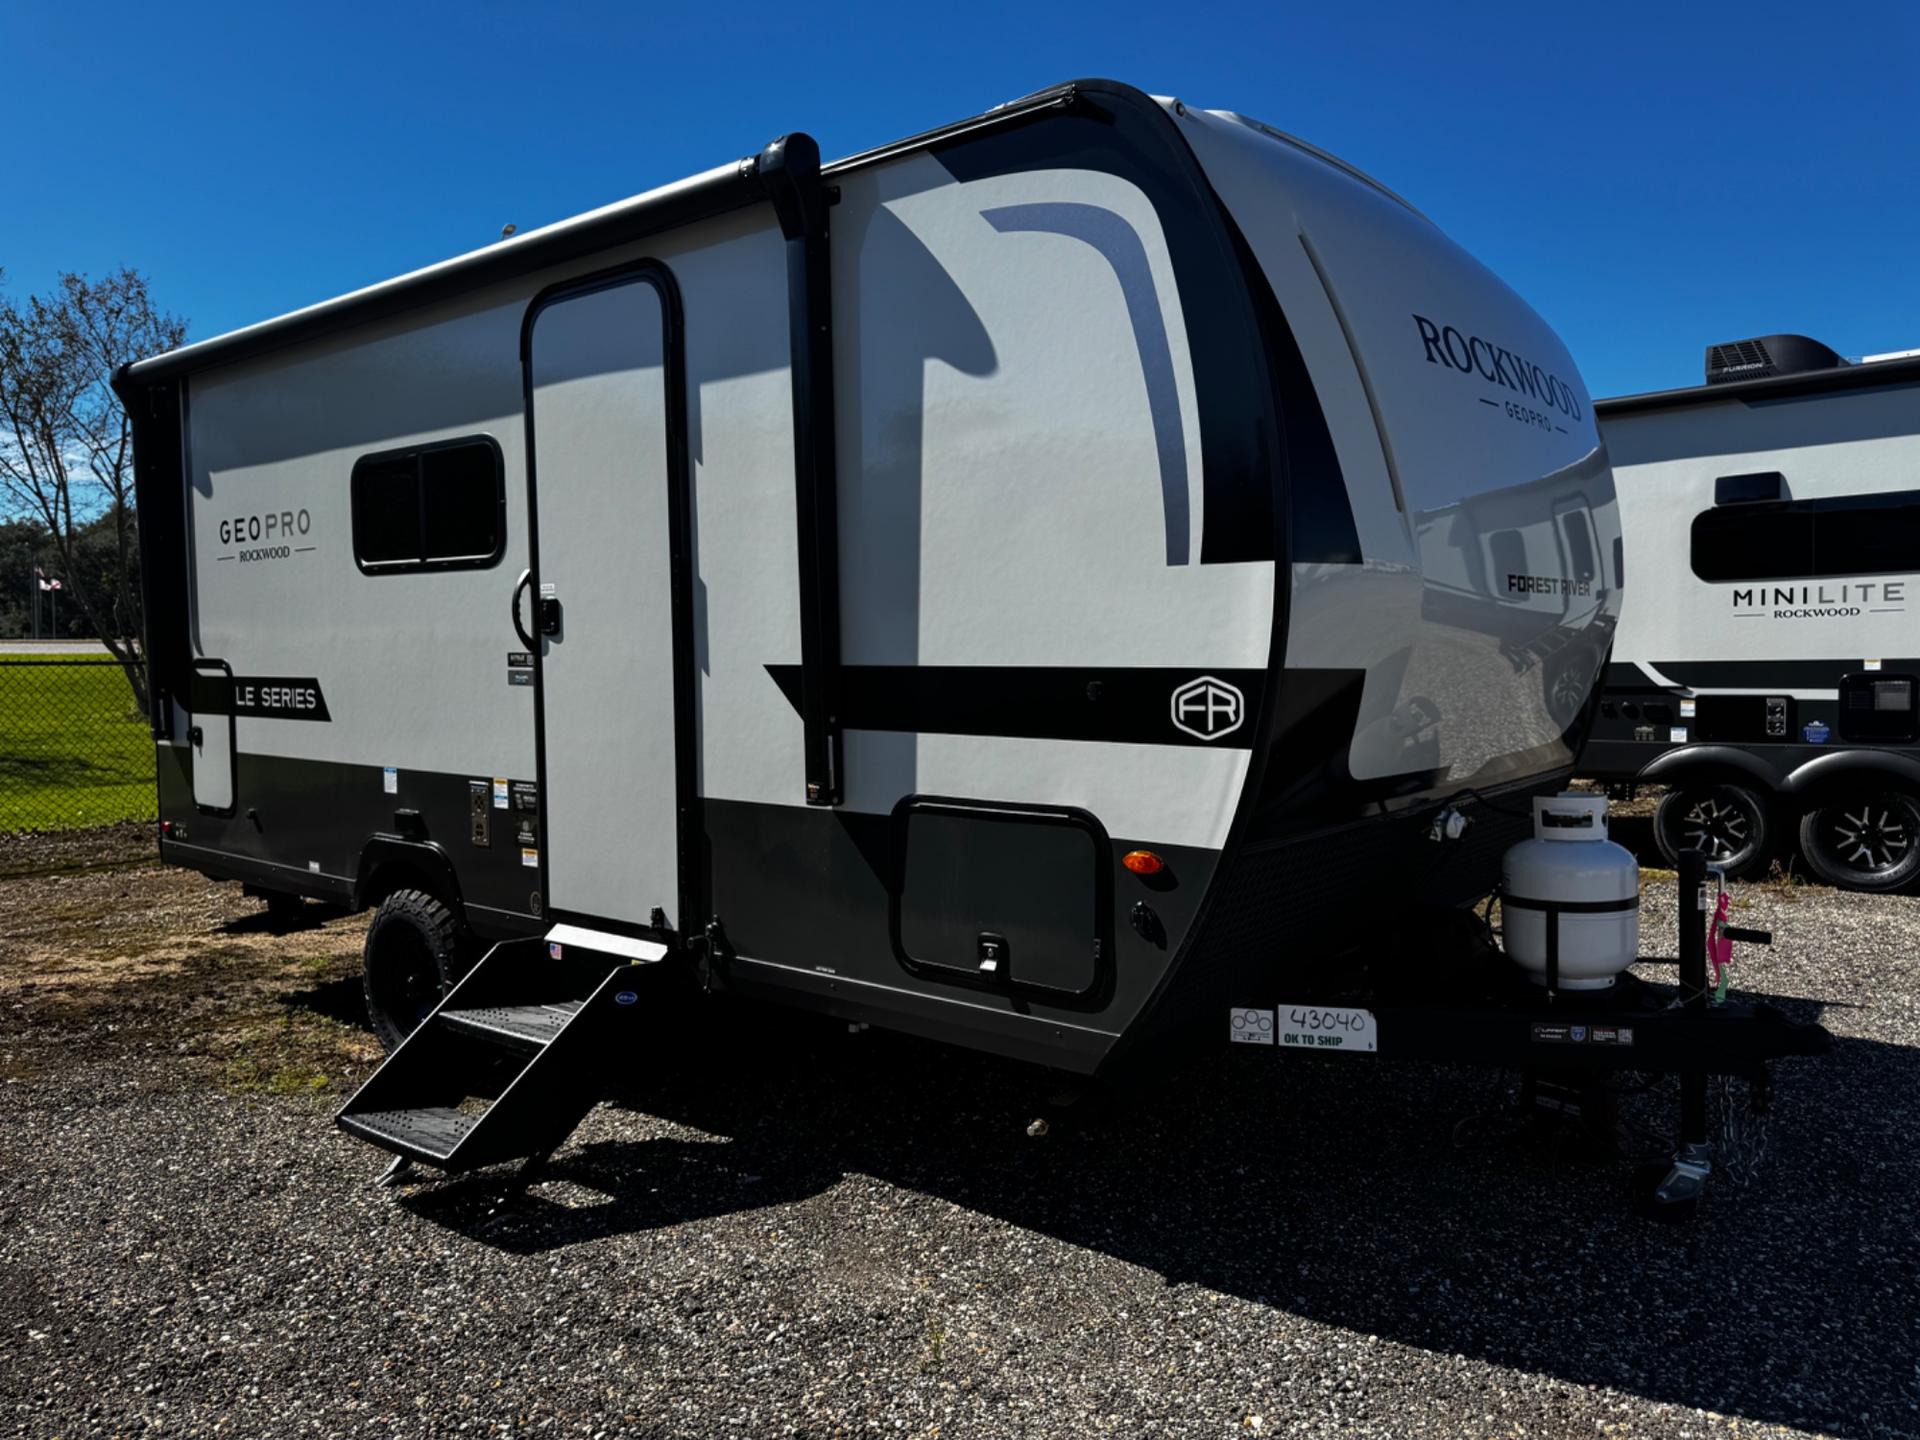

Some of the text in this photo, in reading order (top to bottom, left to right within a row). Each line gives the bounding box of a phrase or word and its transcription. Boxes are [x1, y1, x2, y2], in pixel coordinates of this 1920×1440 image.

[1412, 313, 1582, 423] ROCKWOOD
[1504, 401, 1552, 433] GEOPRO
[219, 508, 311, 545] GEOPRO
[239, 546, 290, 563] ROCKWOOD
[1507, 574, 1591, 597] FOREST RIVER
[1733, 582, 1905, 607] MINILITE
[1773, 607, 1861, 619] ROCKWOOD
[235, 686, 317, 709] LE SERIES
[1290, 1008, 1365, 1031] 43040
[1284, 1033, 1343, 1046] OK TO SHIP
